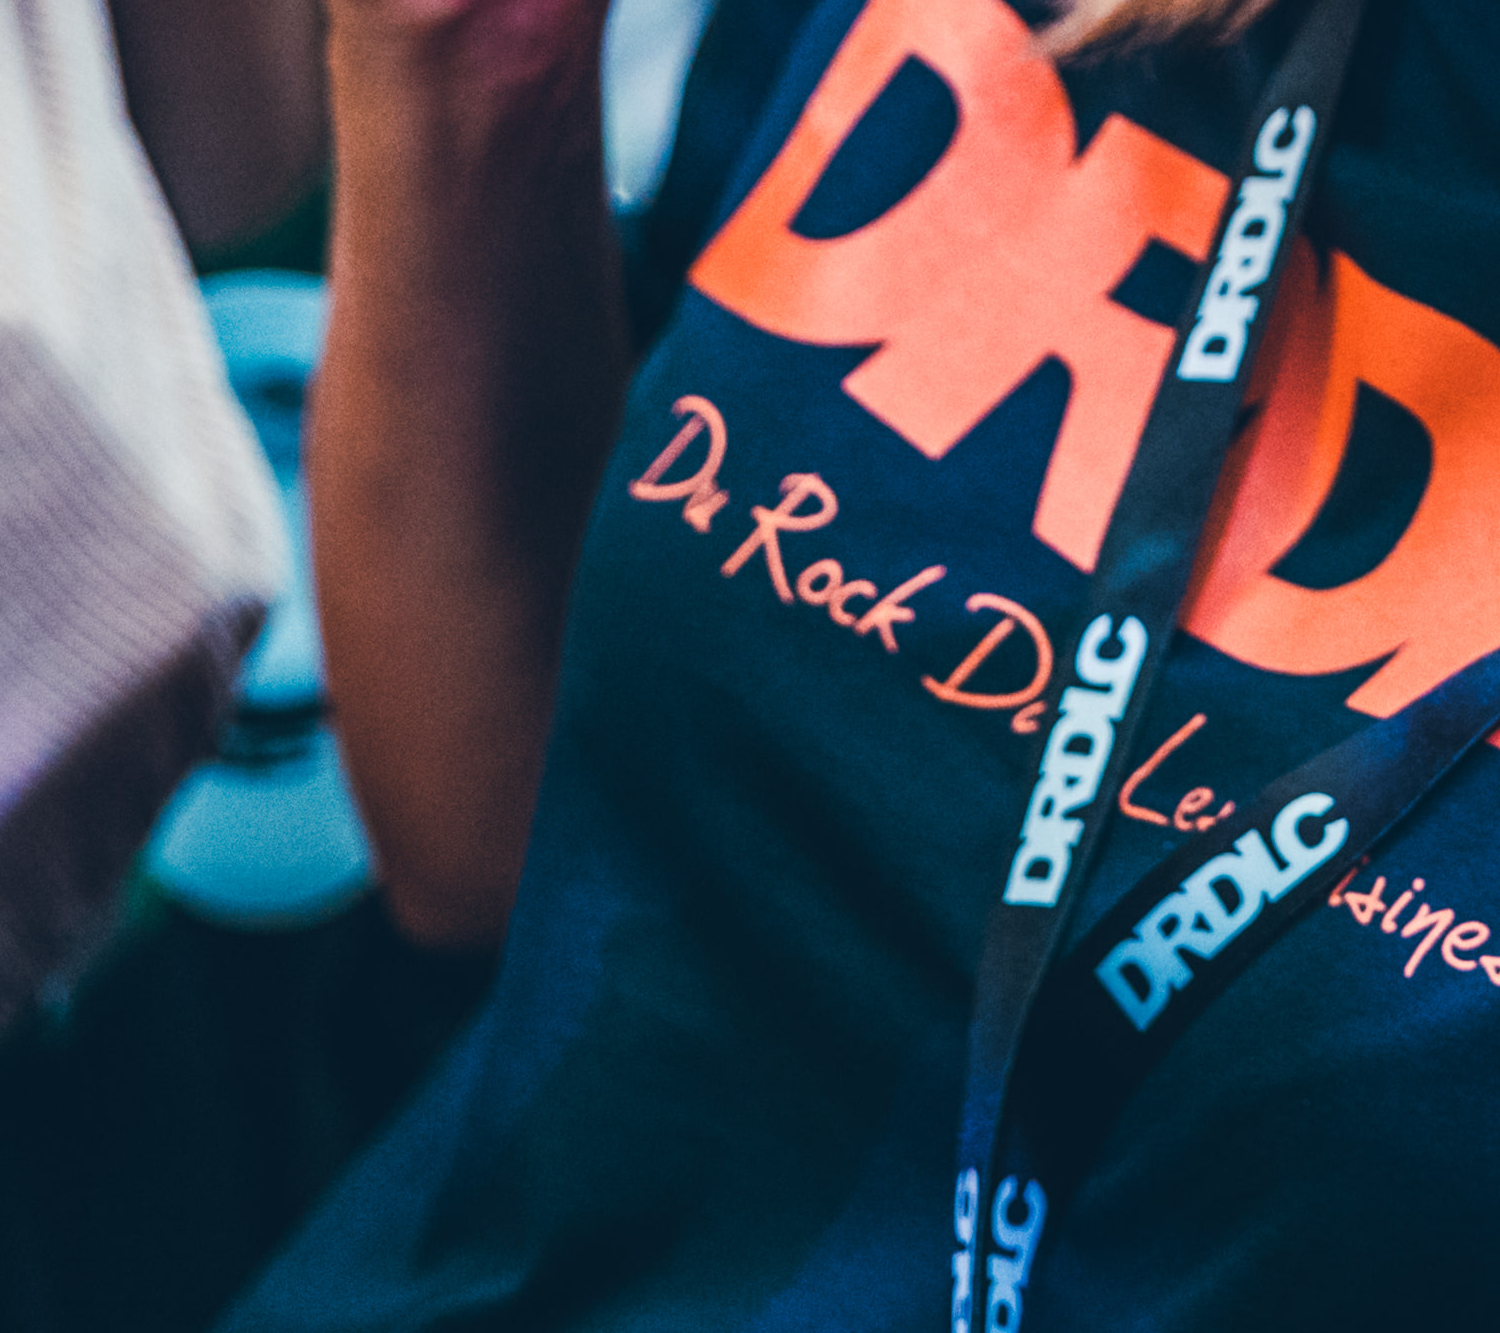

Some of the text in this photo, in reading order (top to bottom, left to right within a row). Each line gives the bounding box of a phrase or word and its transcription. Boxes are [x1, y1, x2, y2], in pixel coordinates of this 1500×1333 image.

[1176, 104, 1317, 382] DRDLC
[720, 472, 947, 653] Rock
[1002, 612, 1149, 909] DRDLC
[1095, 792, 1350, 1031] DRDLC
